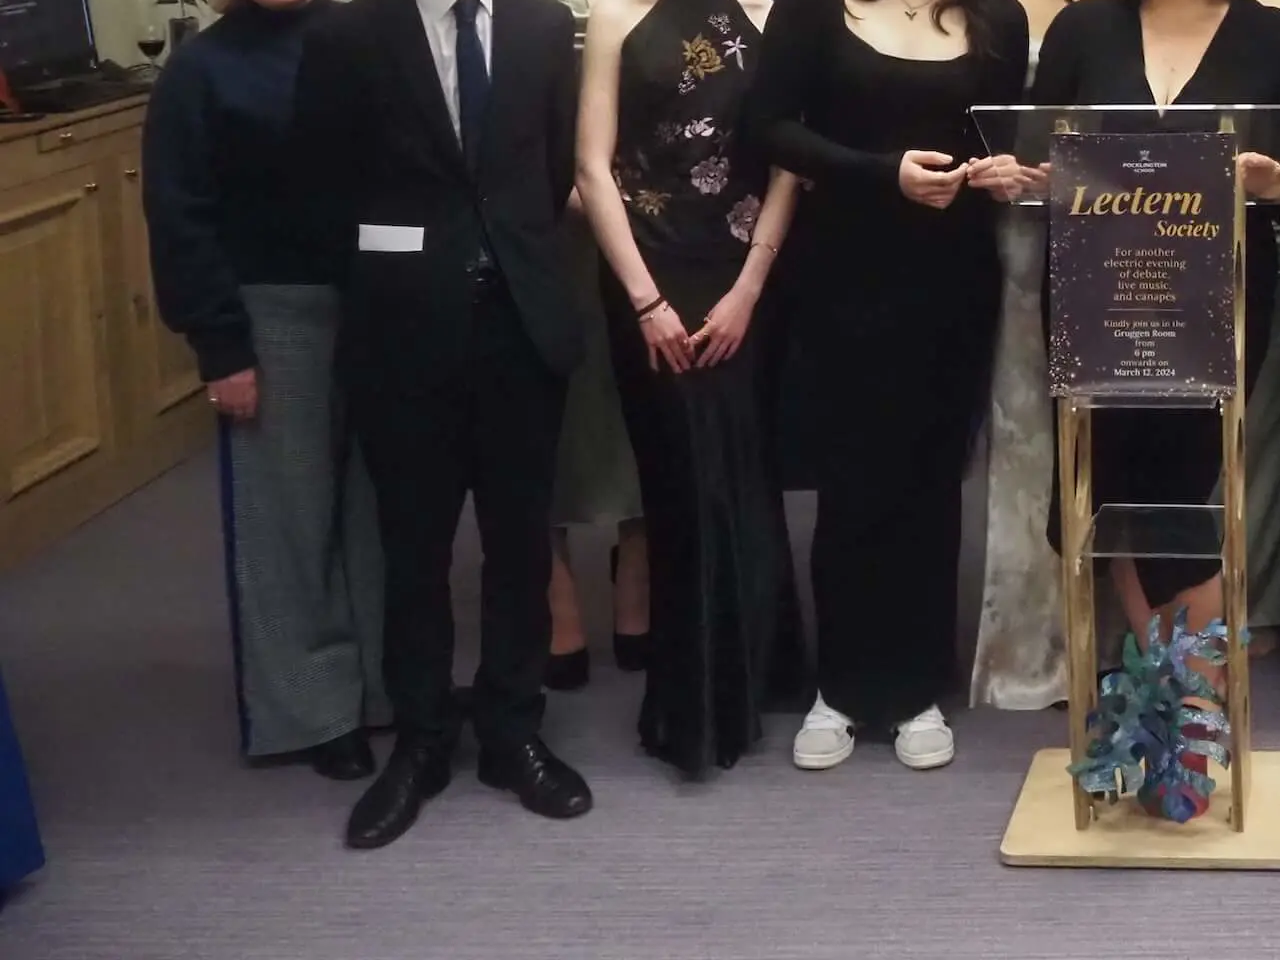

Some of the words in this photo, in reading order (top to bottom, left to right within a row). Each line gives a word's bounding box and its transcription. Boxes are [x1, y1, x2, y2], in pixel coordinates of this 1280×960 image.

[1069, 186, 1202, 215] Lectern
[1155, 219, 1220, 239] Society
[1115, 247, 1133, 257] For
[1135, 247, 1176, 257] another
[1103, 259, 1144, 269] electric
[1146, 259, 1187, 271] evening
[1119, 269, 1131, 279] of
[1118, 280, 1136, 290] live
[1113, 292, 1133, 302] and
[1103, 320, 1131, 329] Kindly
[1132, 320, 1148, 329] join
[1150, 320, 1160, 328] us
[1161, 320, 1171, 328] in
[1172, 320, 1186, 329] the
[1113, 329, 1151, 339] Gruggen
[1151, 329, 1177, 338] Room
[1135, 339, 1156, 348] from
[1134, 349, 1140, 357] 6
[1141, 349, 1156, 359] pm
[1120, 359, 1157, 367] onwards
[1158, 359, 1170, 367] on
[1113, 368, 1141, 377] March
[1155, 368, 1176, 377] 2024
